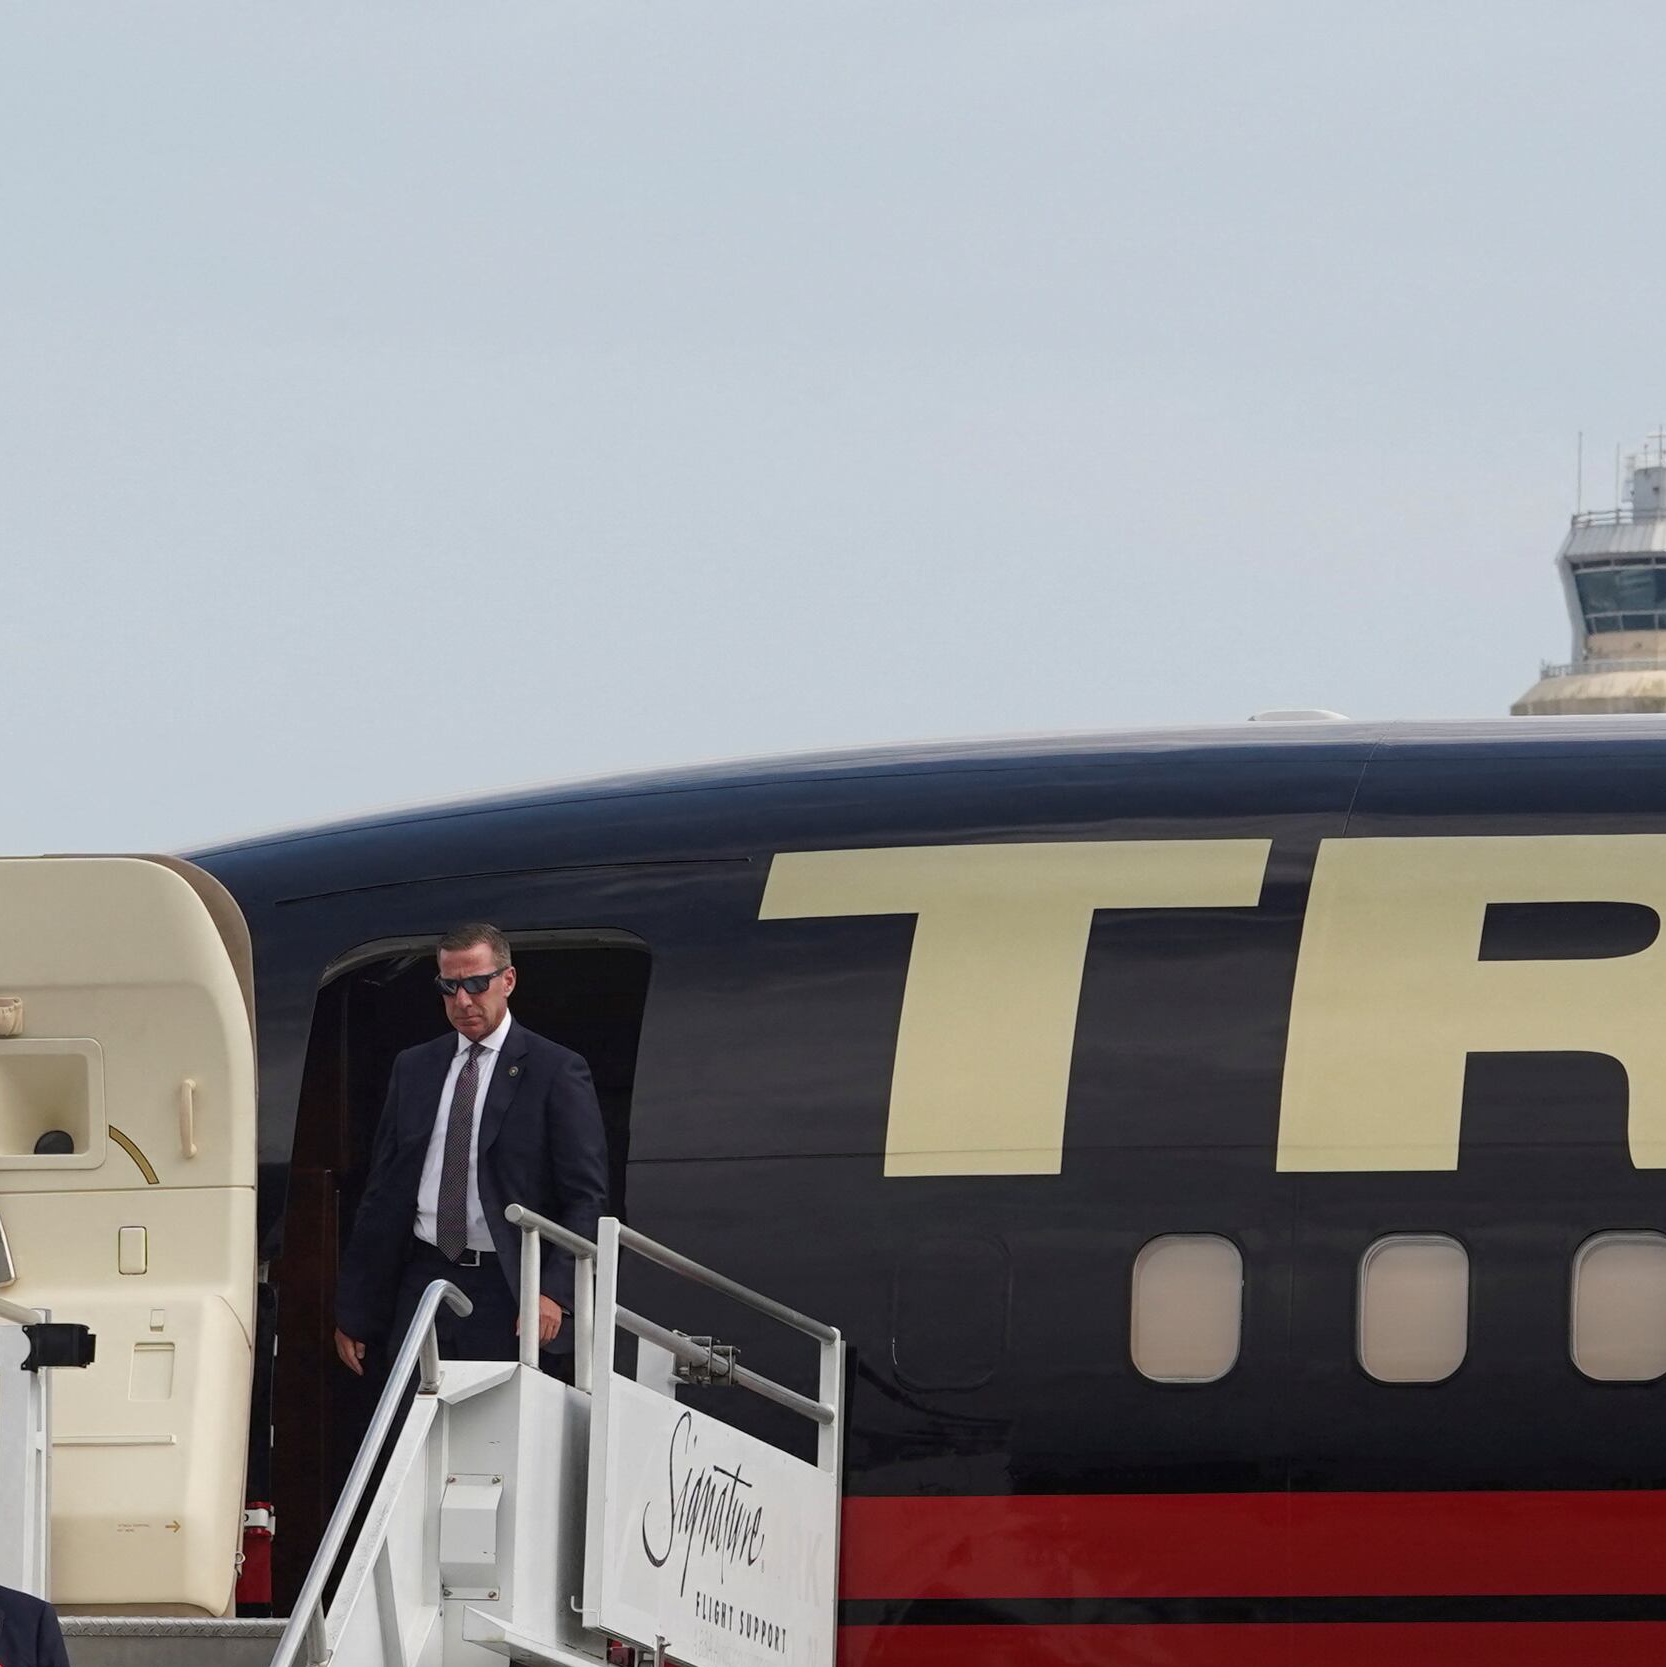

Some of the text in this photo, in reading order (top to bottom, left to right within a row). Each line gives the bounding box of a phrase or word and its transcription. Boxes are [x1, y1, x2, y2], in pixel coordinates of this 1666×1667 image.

[642, 1411, 765, 1597] Signature
[696, 1591, 786, 1654] FLIGHT SUPPORT
